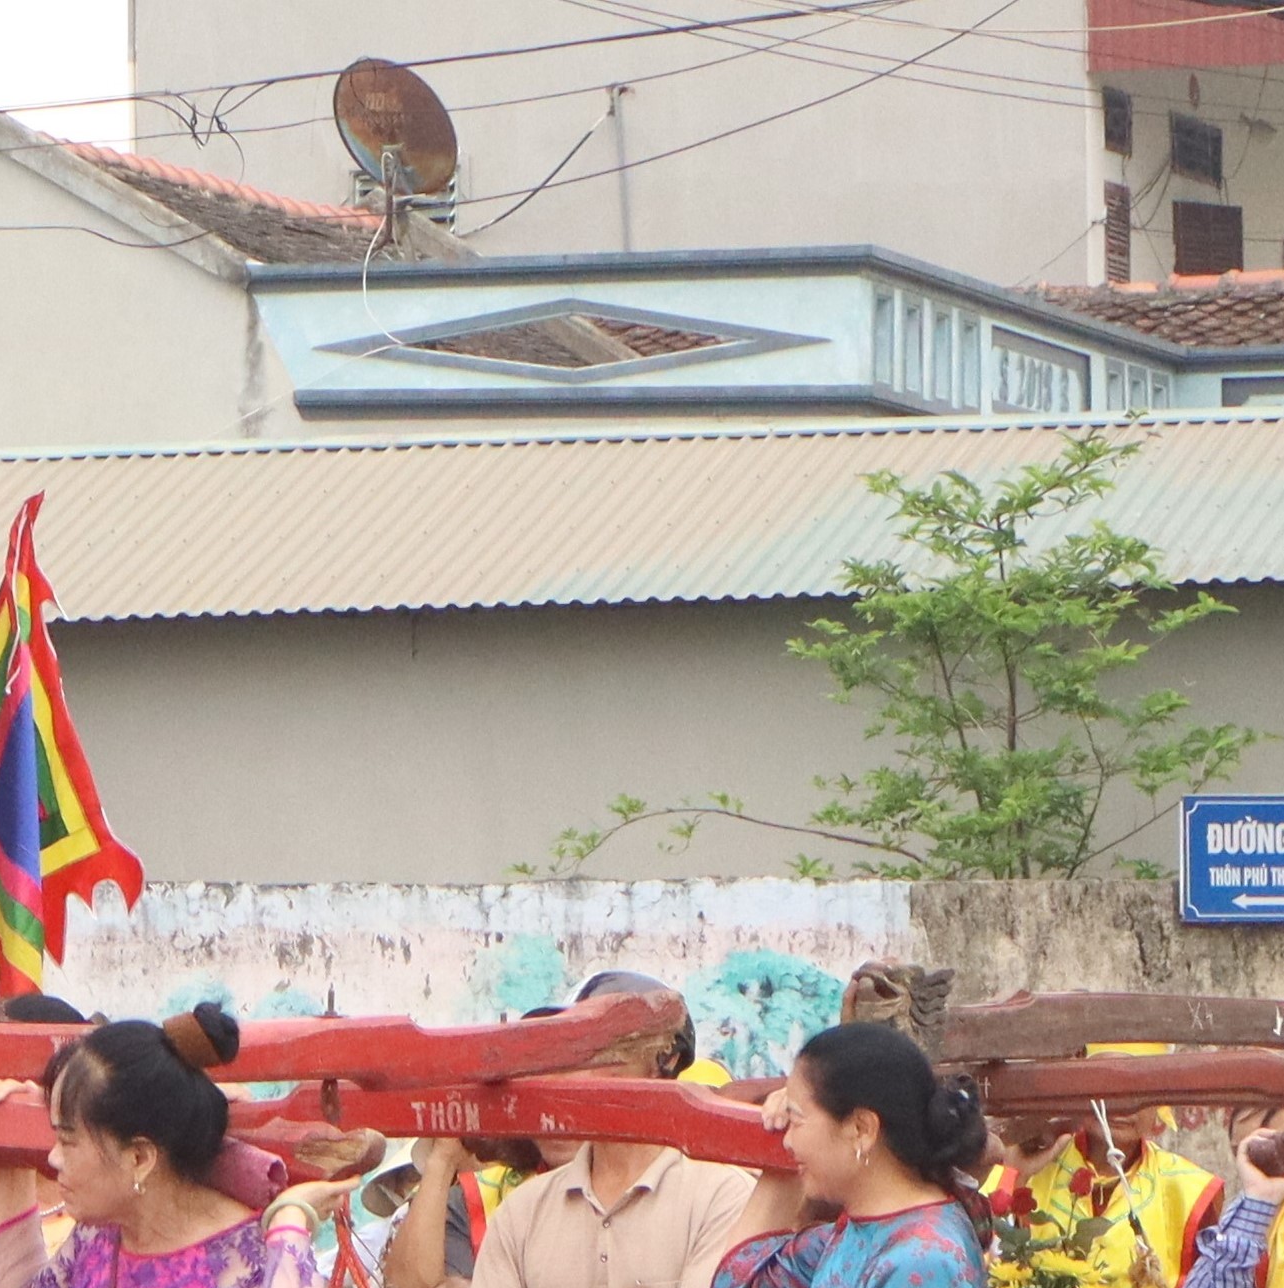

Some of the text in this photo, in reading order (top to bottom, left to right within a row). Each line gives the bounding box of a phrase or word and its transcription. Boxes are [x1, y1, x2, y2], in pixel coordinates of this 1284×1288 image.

[1209, 864, 1241, 887] THÔN
[1244, 863, 1267, 887] PHÚ
[410, 1090, 482, 1133] THÔN
